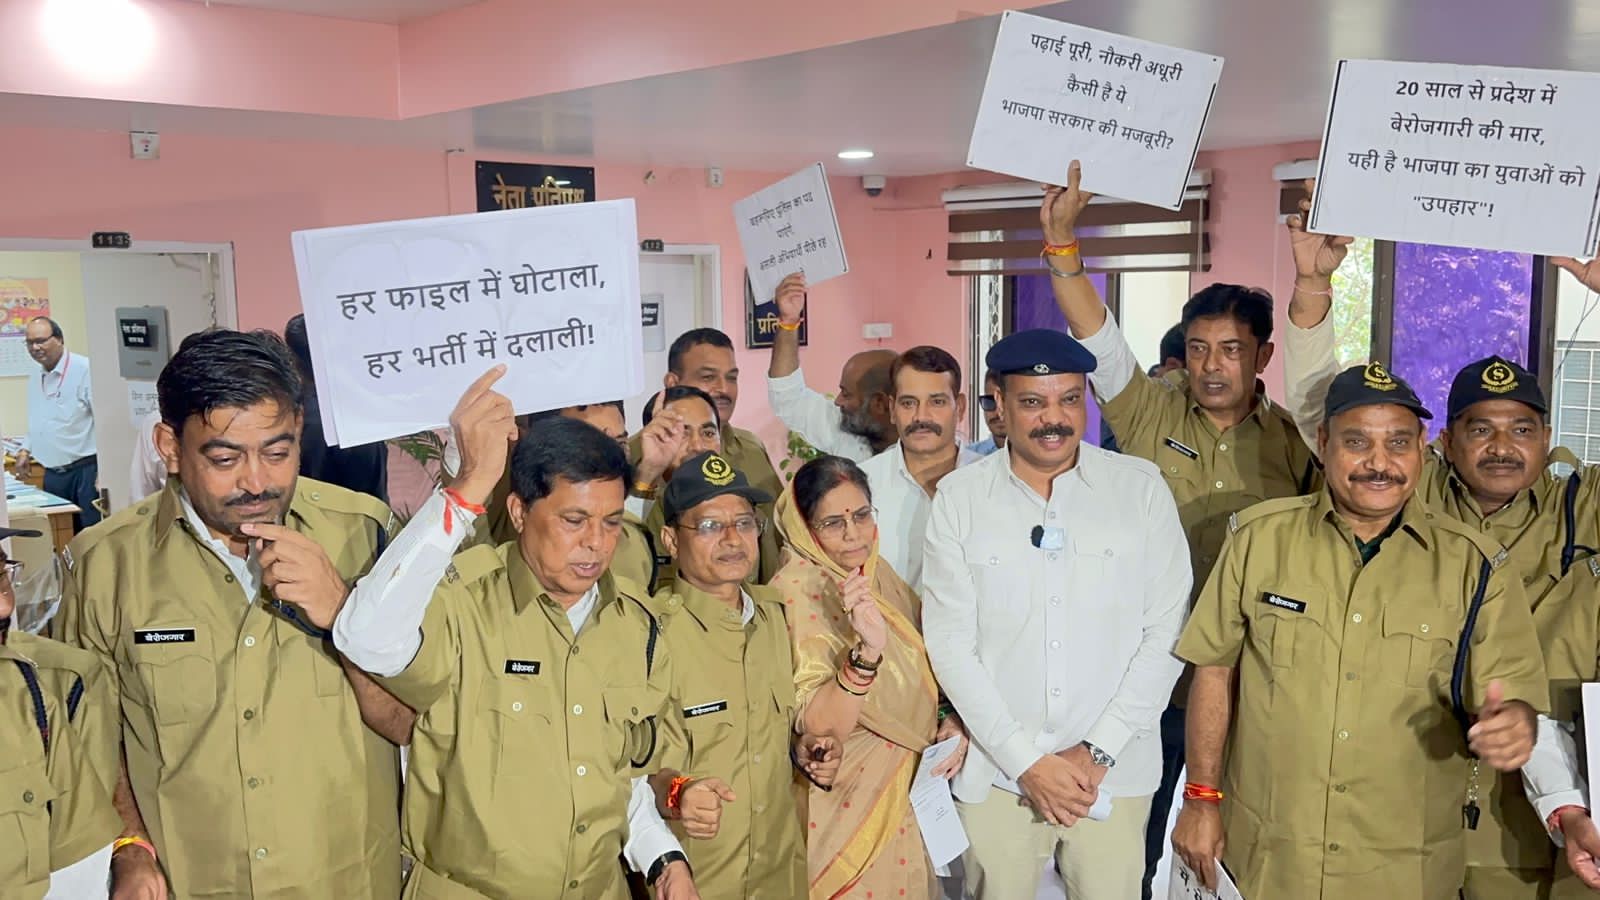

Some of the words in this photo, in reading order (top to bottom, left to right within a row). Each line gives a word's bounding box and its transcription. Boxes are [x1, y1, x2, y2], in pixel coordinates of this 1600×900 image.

[1031, 33, 1067, 57] पढ़ाई
[1068, 40, 1093, 63] पूरी,
[1098, 45, 1143, 72] नौकरी
[1144, 60, 1184, 83] अधूरी
[1066, 72, 1100, 98] कैसी
[1101, 80, 1114, 103] है
[1115, 84, 1128, 105] ये
[1395, 80, 1420, 97] 20
[1424, 81, 1465, 99] साल
[1467, 79, 1486, 101] से
[1489, 80, 1537, 105] प्रदेश
[1539, 82, 1559, 105] में
[1001, 99, 1046, 121] भाजपा
[1048, 109, 1097, 133] सरकार
[1098, 118, 1119, 137] की
[1121, 126, 1175, 150] मजबूरी?
[1390, 111, 1475, 138] बेरोजगारी
[1477, 119, 1505, 141] की
[1508, 125, 1545, 147] मार,
[1347, 148, 1381, 171] यही
[1383, 149, 1399, 174] है
[1402, 156, 1461, 177] भाजपा
[1463, 162, 1491, 179] का
[1494, 162, 1555, 185] युवाओं
[1558, 164, 1587, 188] को
[1413, 195, 1495, 218] "उपहार"!
[335, 290, 377, 321] हर
[384, 279, 471, 311] फाइल
[477, 268, 502, 300] में
[508, 263, 606, 296] घोटाला,
[362, 349, 403, 380] हर
[412, 331, 468, 369] भर्ती
[473, 329, 498, 360] में
[503, 317, 595, 359] दलाली!
[1492, 368, 1505, 381] S
[710, 461, 723, 473] S
